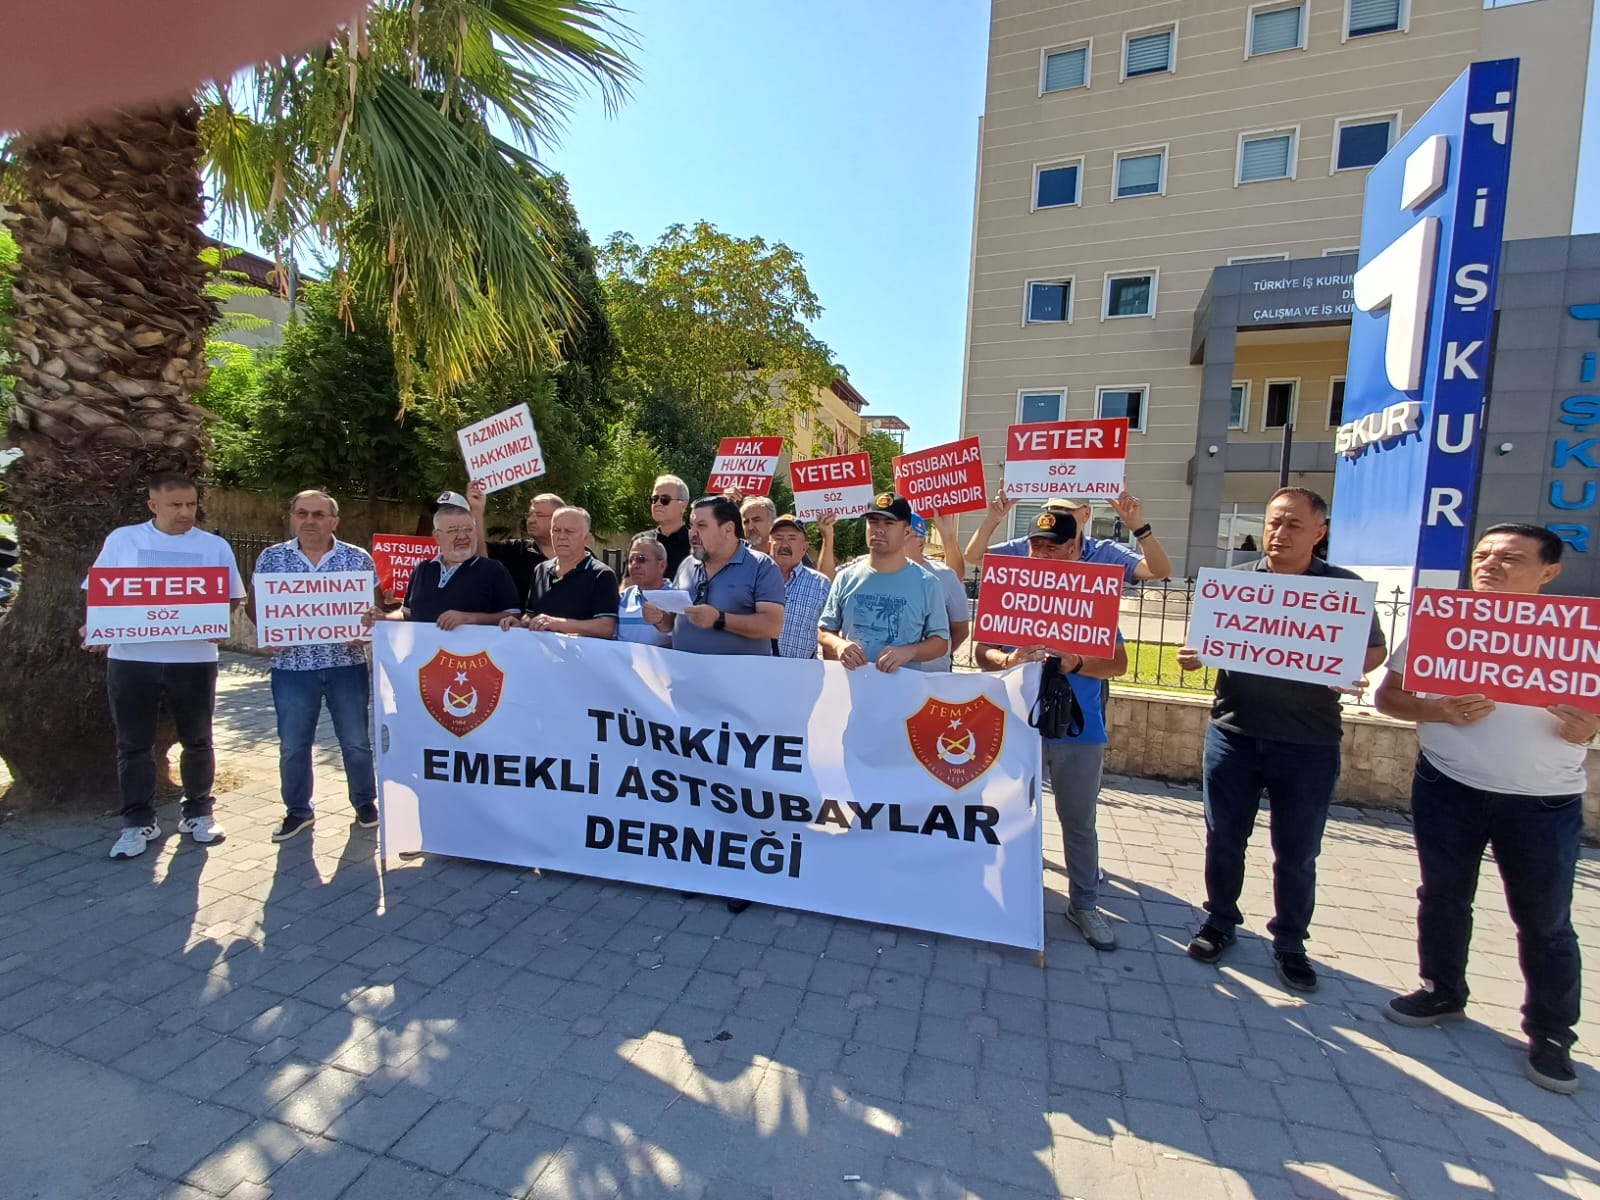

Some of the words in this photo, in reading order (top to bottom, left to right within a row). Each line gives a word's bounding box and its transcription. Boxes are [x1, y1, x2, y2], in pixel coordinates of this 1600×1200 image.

[1253, 278, 1300, 291] TÜRKİYE
[1302, 276, 1313, 288] İŞ
[1253, 308, 1301, 321] ÇALIŞMA
[1304, 306, 1319, 315] VE
[464, 412, 524, 448] TAZMİNAT
[1013, 427, 1104, 451] YETER
[1112, 427, 1121, 448] !
[470, 435, 534, 470] HAKKIMIZI
[734, 441, 764, 455] HAK
[720, 458, 768, 472] HUKUK
[795, 460, 856, 483] YETER
[895, 446, 980, 479] ASTSUBAYLAR
[1048, 463, 1076, 476] SÖZ
[712, 475, 767, 490] ADALET
[908, 469, 968, 495] ORDUNUN
[1006, 482, 1120, 494] ASTSUBAYLARIN
[823, 492, 843, 502] SÖZ
[907, 485, 983, 513] MURGASIDIR
[265, 576, 367, 594] TAZMİNAT
[393, 568, 412, 578] HA
[983, 565, 1119, 596] ASTSUBAYLAR
[100, 577, 207, 597] YETER
[217, 577, 224, 595] !
[1201, 578, 1275, 606] ÖVGÜ
[1282, 589, 1366, 616] DEĞİL
[146, 608, 180, 621] SÖZ
[1001, 591, 1094, 619] ORDUNUN
[1415, 594, 1600, 631] ASTSUBAYL
[91, 623, 229, 639] ASTSUBAYLARIN
[264, 624, 373, 642] İSTİYORUZ
[979, 613, 1111, 647] OMURGASIDIR
[1213, 611, 1343, 644] TAZMİNAT
[1202, 635, 1344, 676] İSTİYORUZ
[1445, 627, 1600, 664] ORDUNUN
[439, 655, 488, 670] TEMAD
[588, 708, 804, 774] TÜRKİYE
[424, 748, 600, 794] EMEKLİ
[616, 765, 1000, 846] ASTSUBAYLAR
[585, 815, 802, 878] DERNEĞİ
